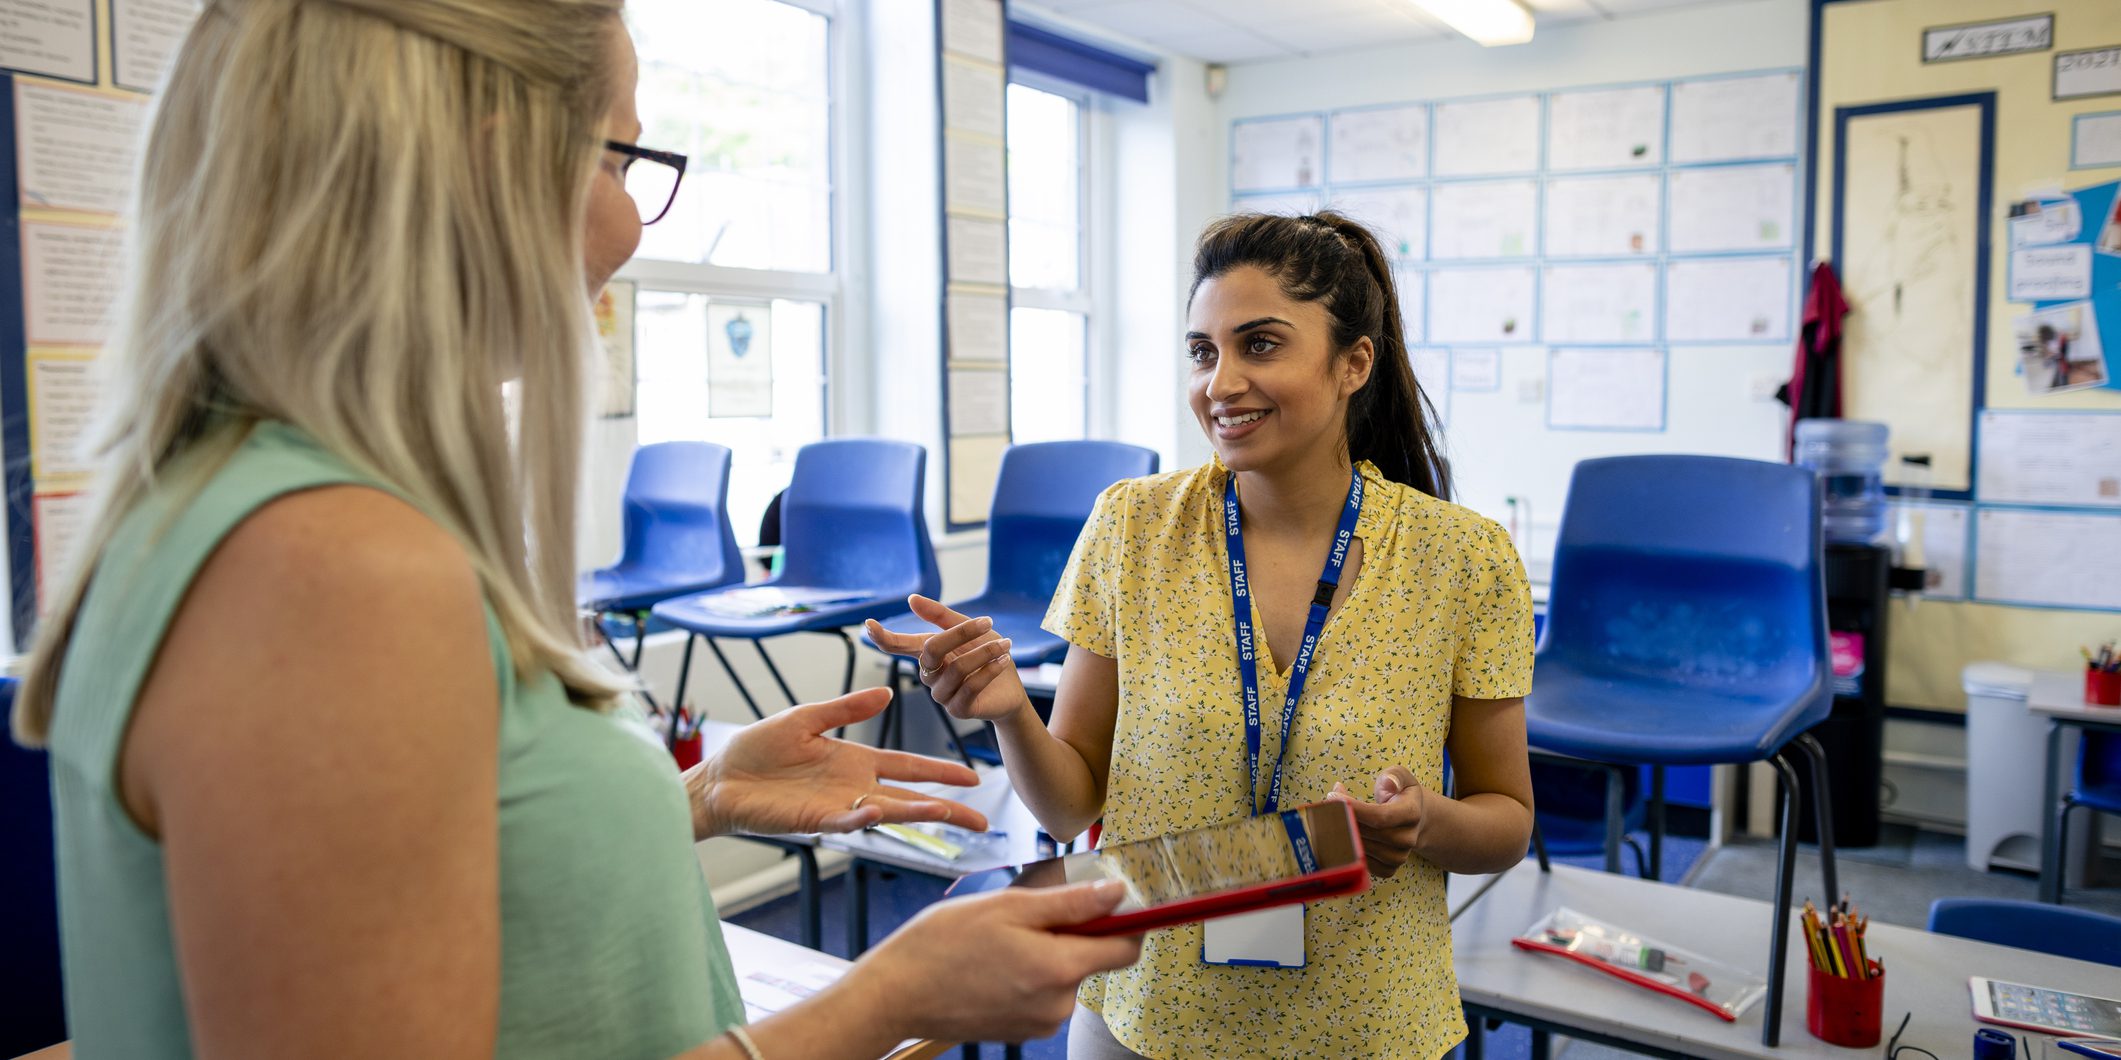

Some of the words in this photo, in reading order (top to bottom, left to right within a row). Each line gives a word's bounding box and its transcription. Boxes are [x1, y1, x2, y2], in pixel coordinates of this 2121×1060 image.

[1351, 474, 1362, 510] STAFF
[1227, 500, 1239, 535] STAFF
[1331, 529, 1350, 567] STAFF
[1233, 559, 1246, 597] STAFF
[1240, 621, 1253, 661] STAFF
[1297, 634, 1315, 674] STAFF
[1246, 686, 1258, 726] STAFF
[1282, 697, 1295, 737] STAFF
[1271, 764, 1282, 803] STAFF
